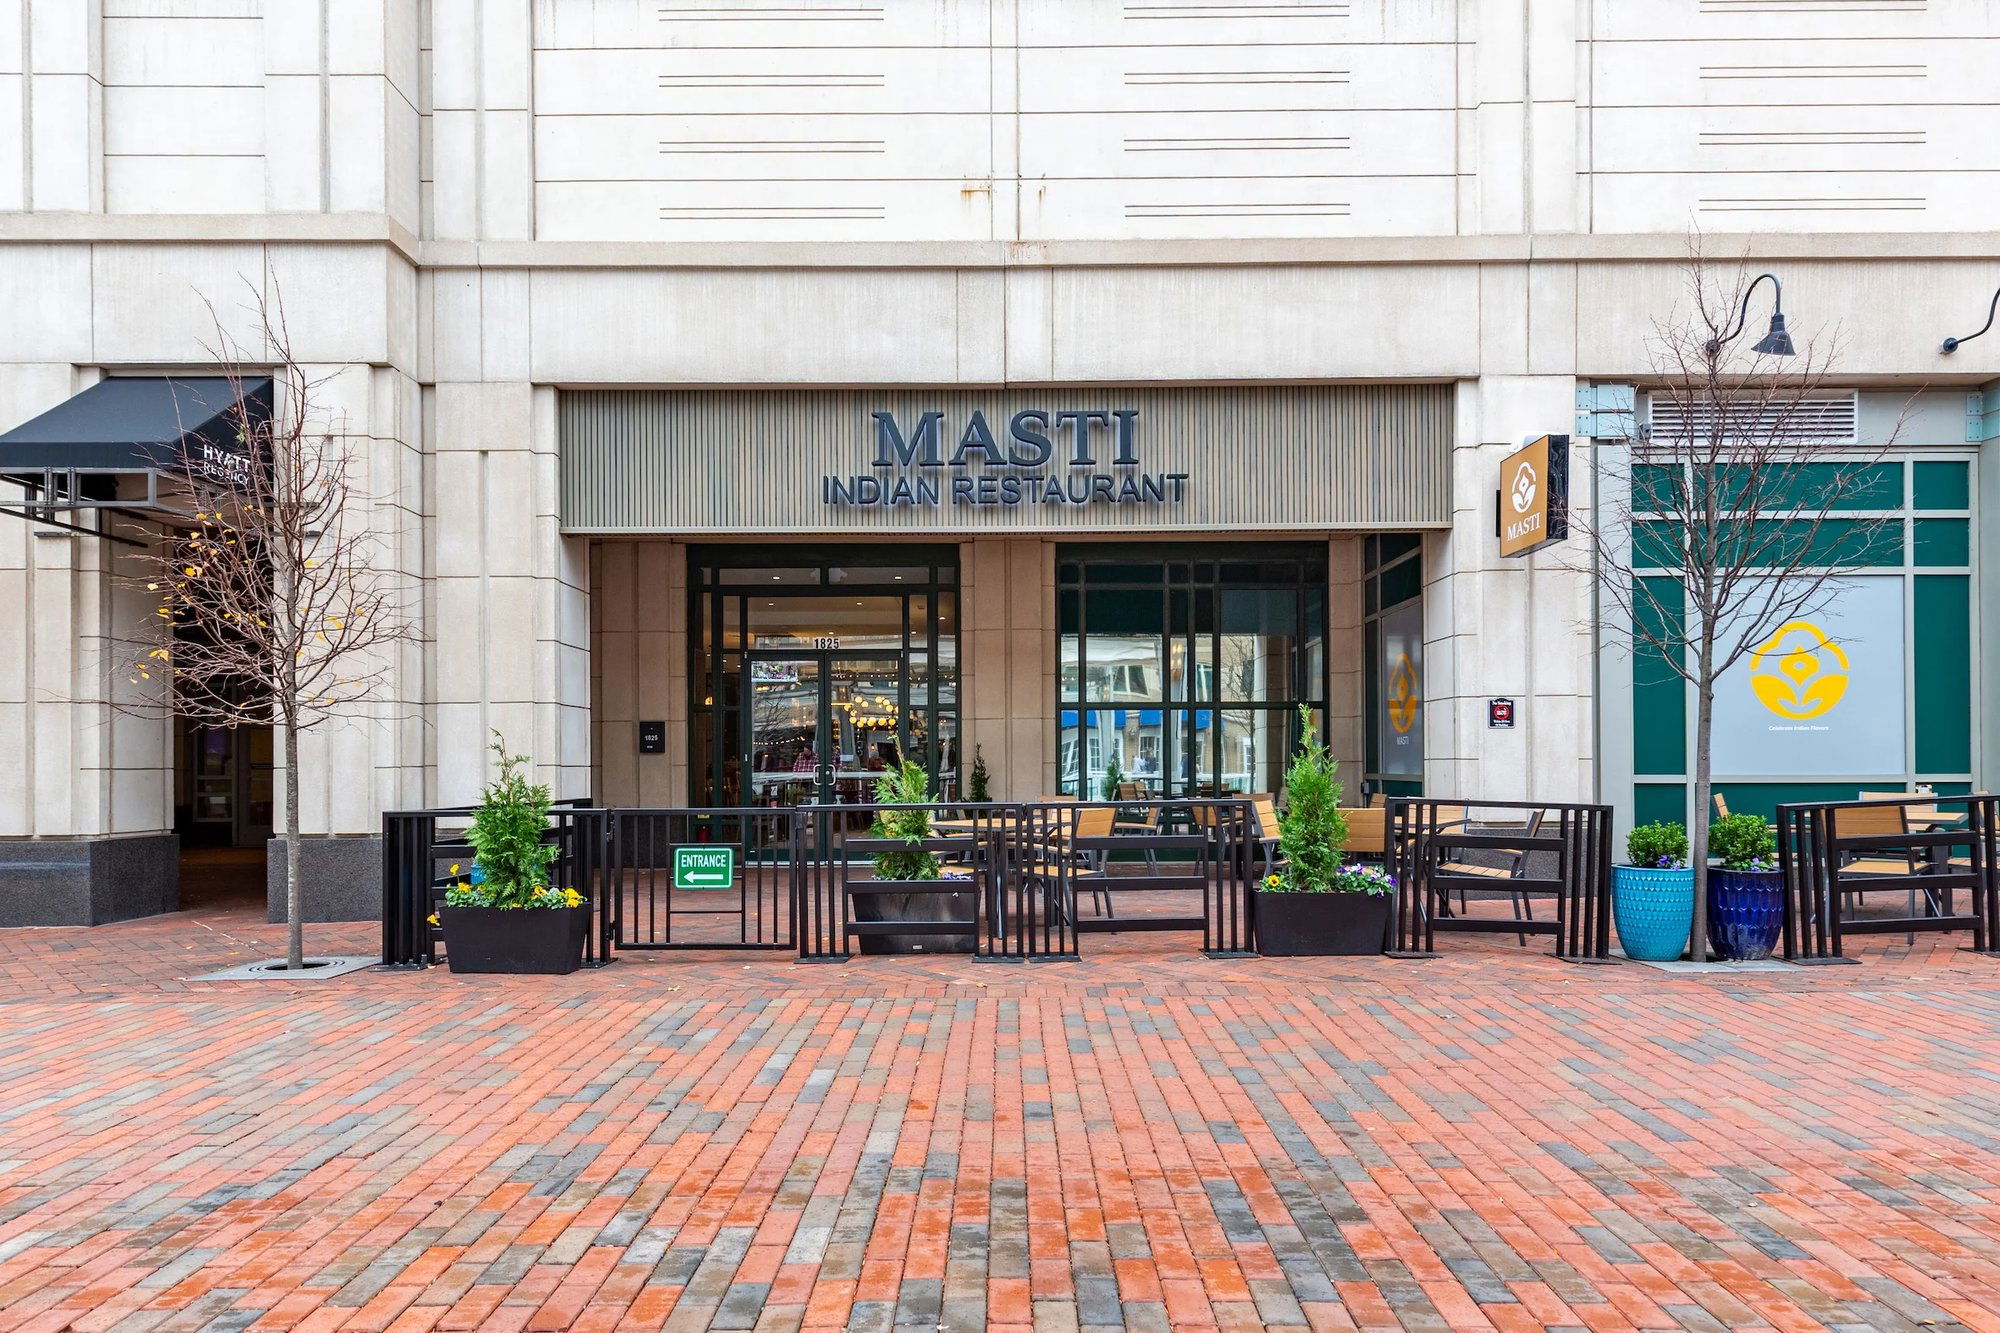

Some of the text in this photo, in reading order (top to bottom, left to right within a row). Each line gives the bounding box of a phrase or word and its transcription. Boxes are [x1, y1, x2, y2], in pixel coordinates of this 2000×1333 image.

[871, 409, 1140, 466] MASTI
[203, 444, 250, 472] HYATT
[203, 461, 250, 485] REGNCY
[823, 473, 1190, 504] INDIAN RESTAURANT
[1506, 511, 1541, 542] MASTI
[814, 637, 839, 649] 1825
[681, 854, 727, 868] ENTRANCE
